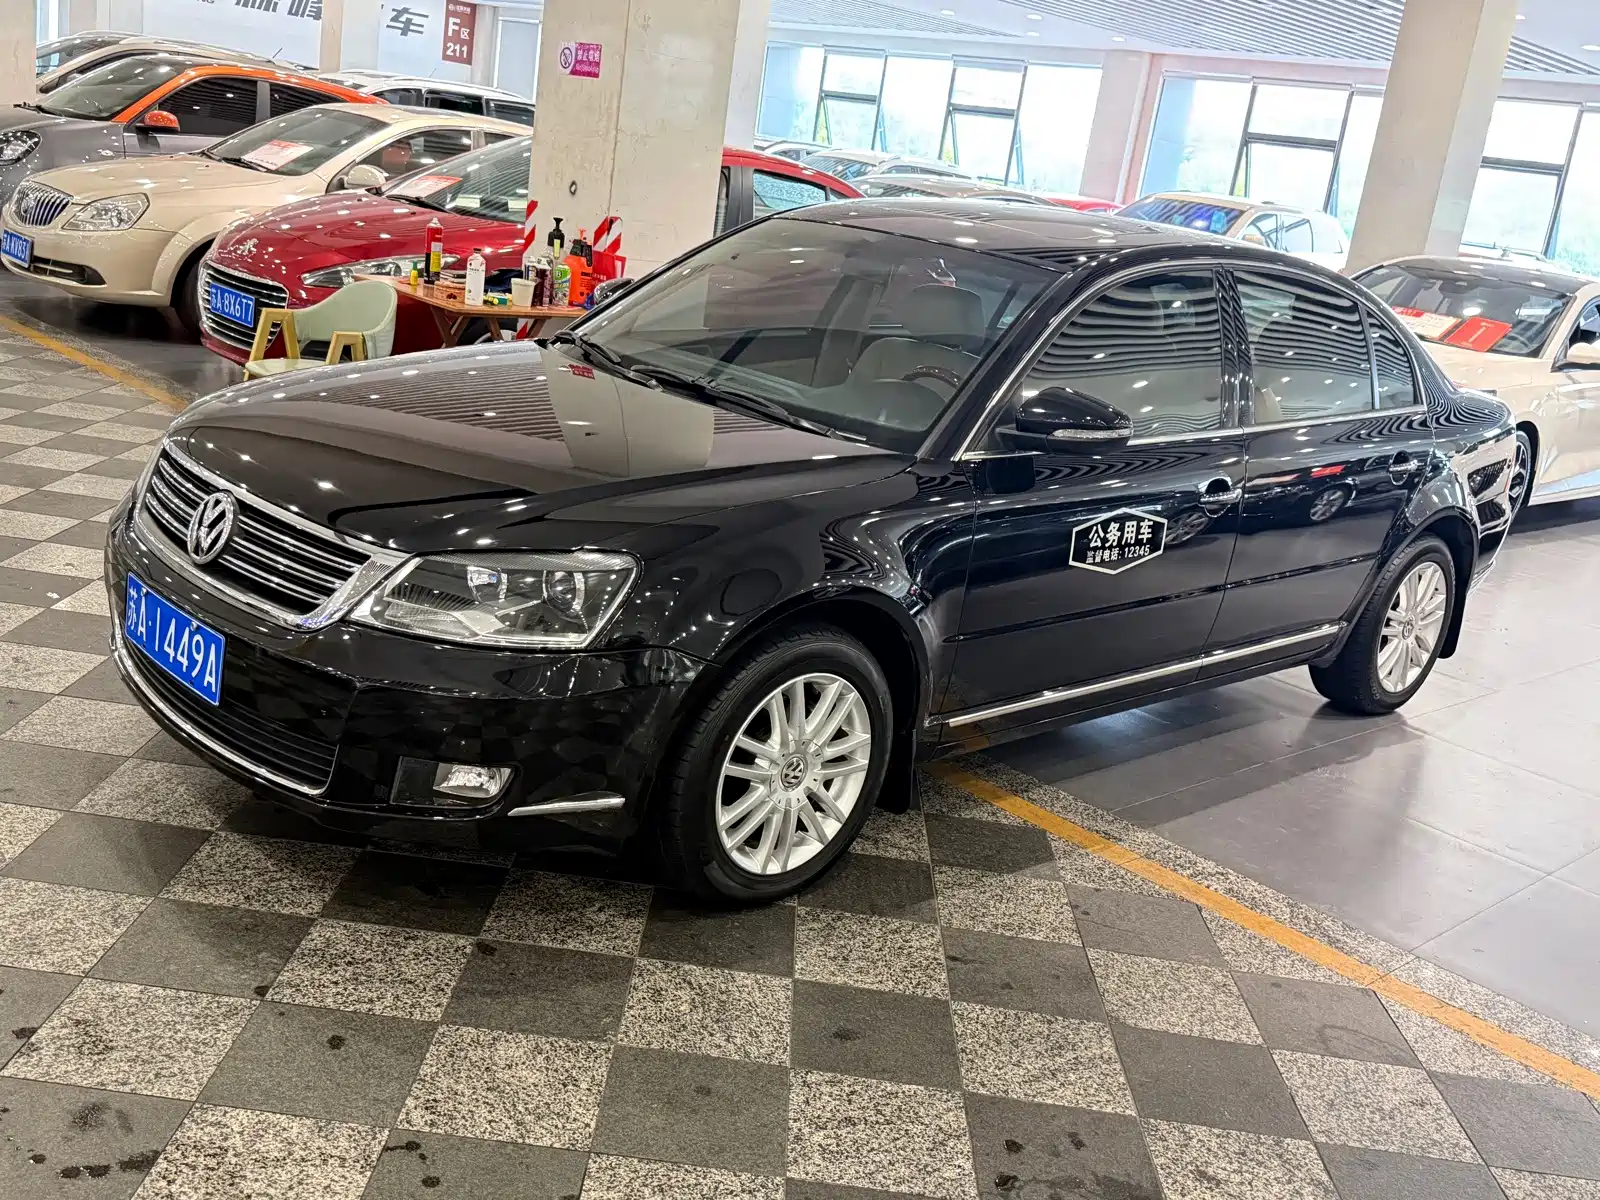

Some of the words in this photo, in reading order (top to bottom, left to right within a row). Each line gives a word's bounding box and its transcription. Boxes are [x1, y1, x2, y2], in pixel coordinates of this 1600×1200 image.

[446, 42, 468, 58] 211
[1088, 519, 1154, 548] 公务用车
[1124, 545, 1151, 558] 12345
